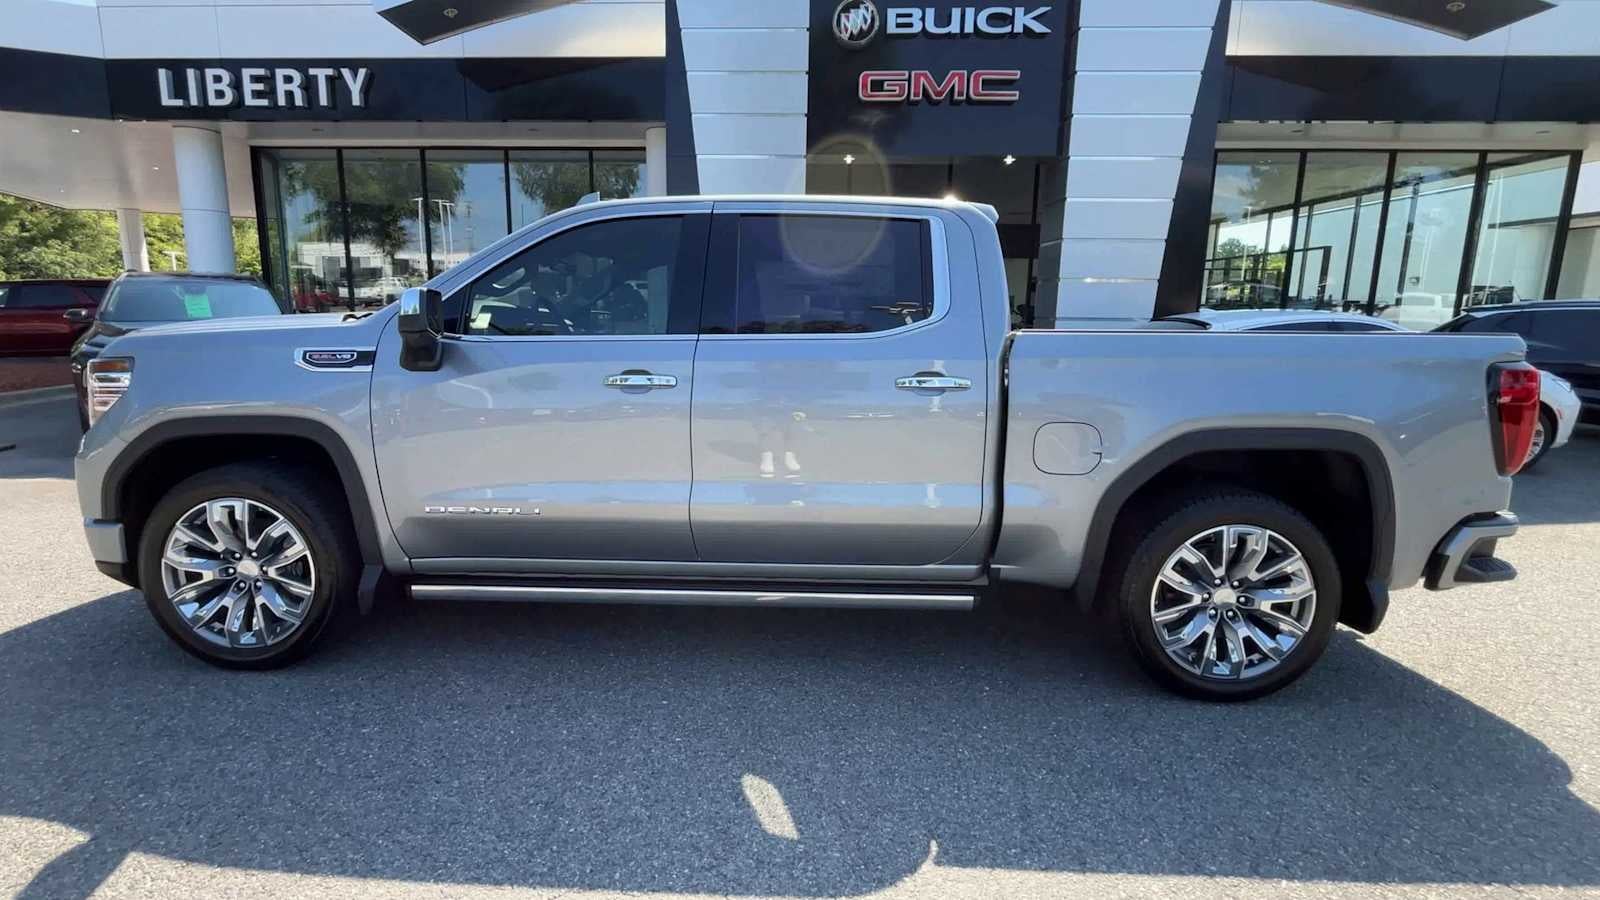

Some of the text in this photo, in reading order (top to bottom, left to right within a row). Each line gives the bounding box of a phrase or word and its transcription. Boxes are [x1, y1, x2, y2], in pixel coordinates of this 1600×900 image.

[886, 6, 1052, 35] BUICK
[157, 67, 369, 107] LIBERTY
[859, 70, 1021, 101] GMC
[424, 505, 541, 515] DENALI
